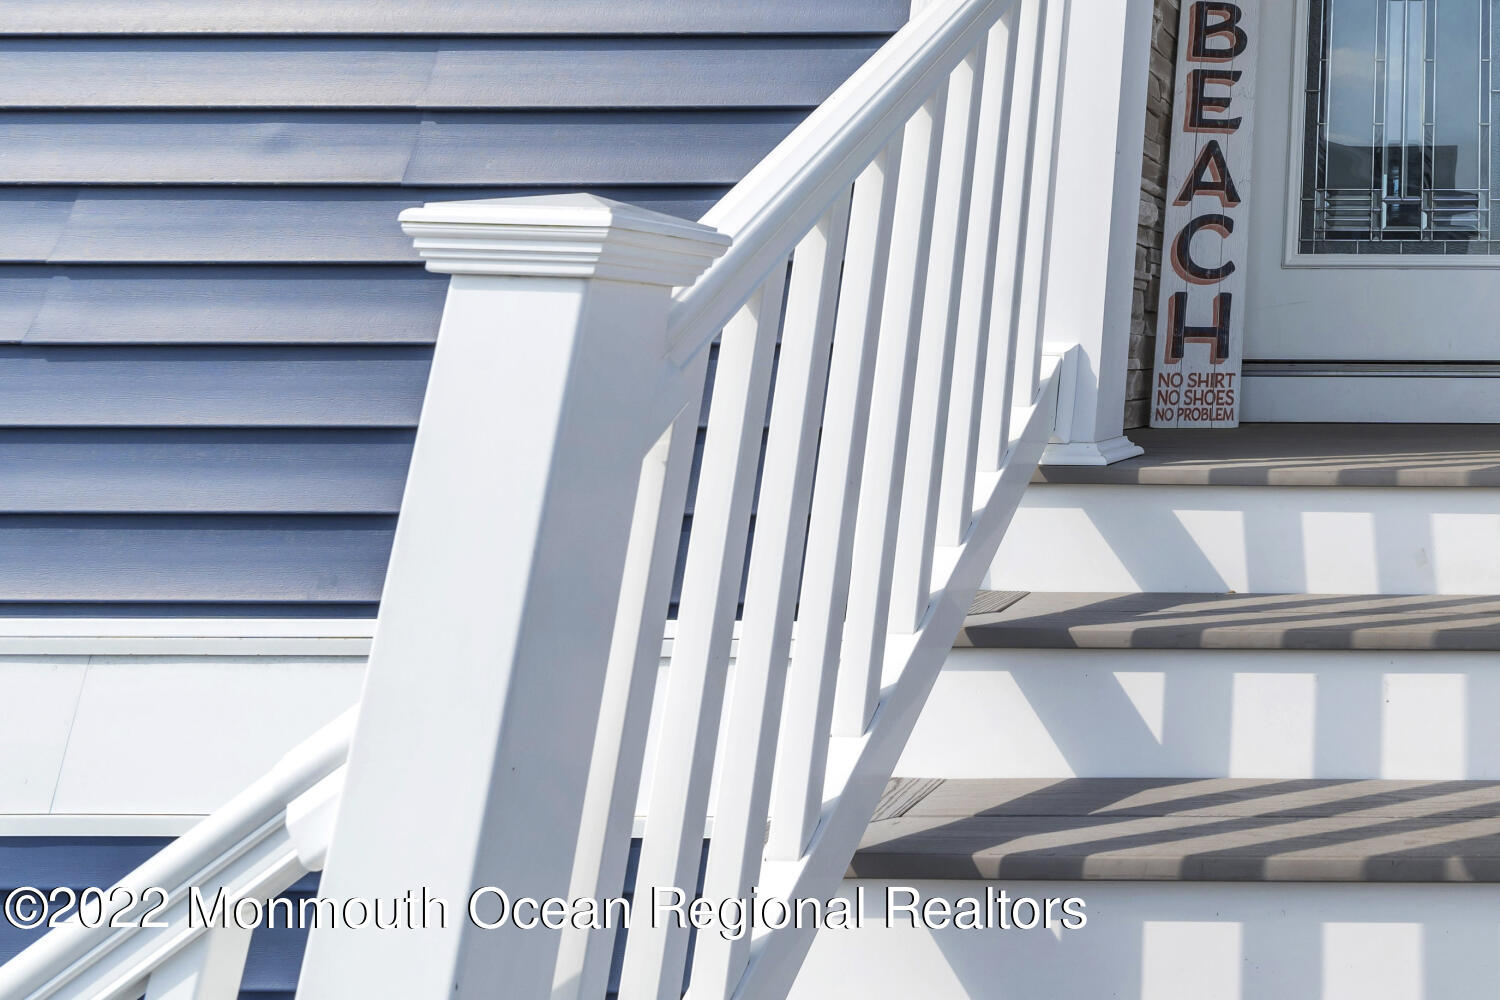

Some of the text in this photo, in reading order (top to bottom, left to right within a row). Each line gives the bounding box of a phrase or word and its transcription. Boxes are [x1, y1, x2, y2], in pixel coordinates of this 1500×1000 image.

[1164, 1, 1248, 364] BEACH
[1157, 372, 1236, 388] NO SHIRT
[1156, 389, 1235, 406] NO SHOES
[1154, 407, 1235, 421] NO PROBLEM
